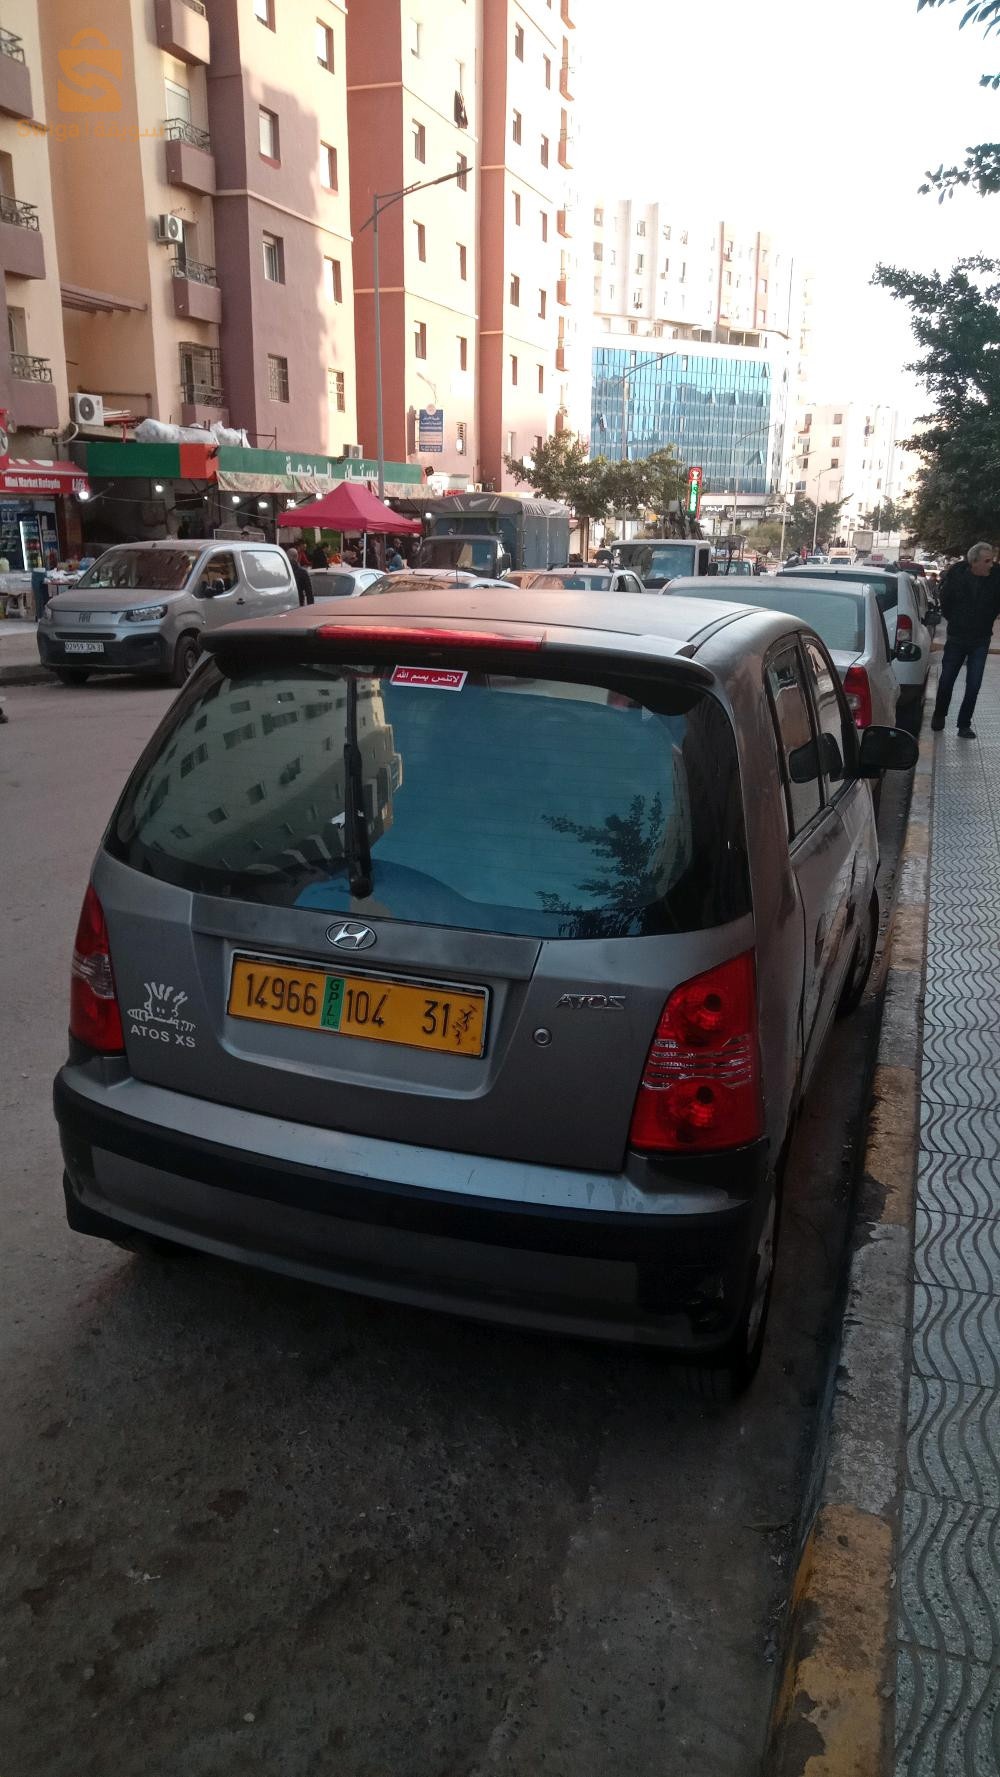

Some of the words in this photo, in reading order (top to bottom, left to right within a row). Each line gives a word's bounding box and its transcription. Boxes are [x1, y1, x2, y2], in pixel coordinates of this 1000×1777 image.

[286, 456, 332, 477] الرحمة
[410, 674, 430, 682] بسم
[247, 973, 317, 1016] 14966
[346, 988, 388, 1027] 104
[422, 1000, 451, 1037] 31
[552, 993, 626, 1010] ATOS
[130, 1024, 170, 1042] ATOS
[175, 1033, 196, 1048] XS
